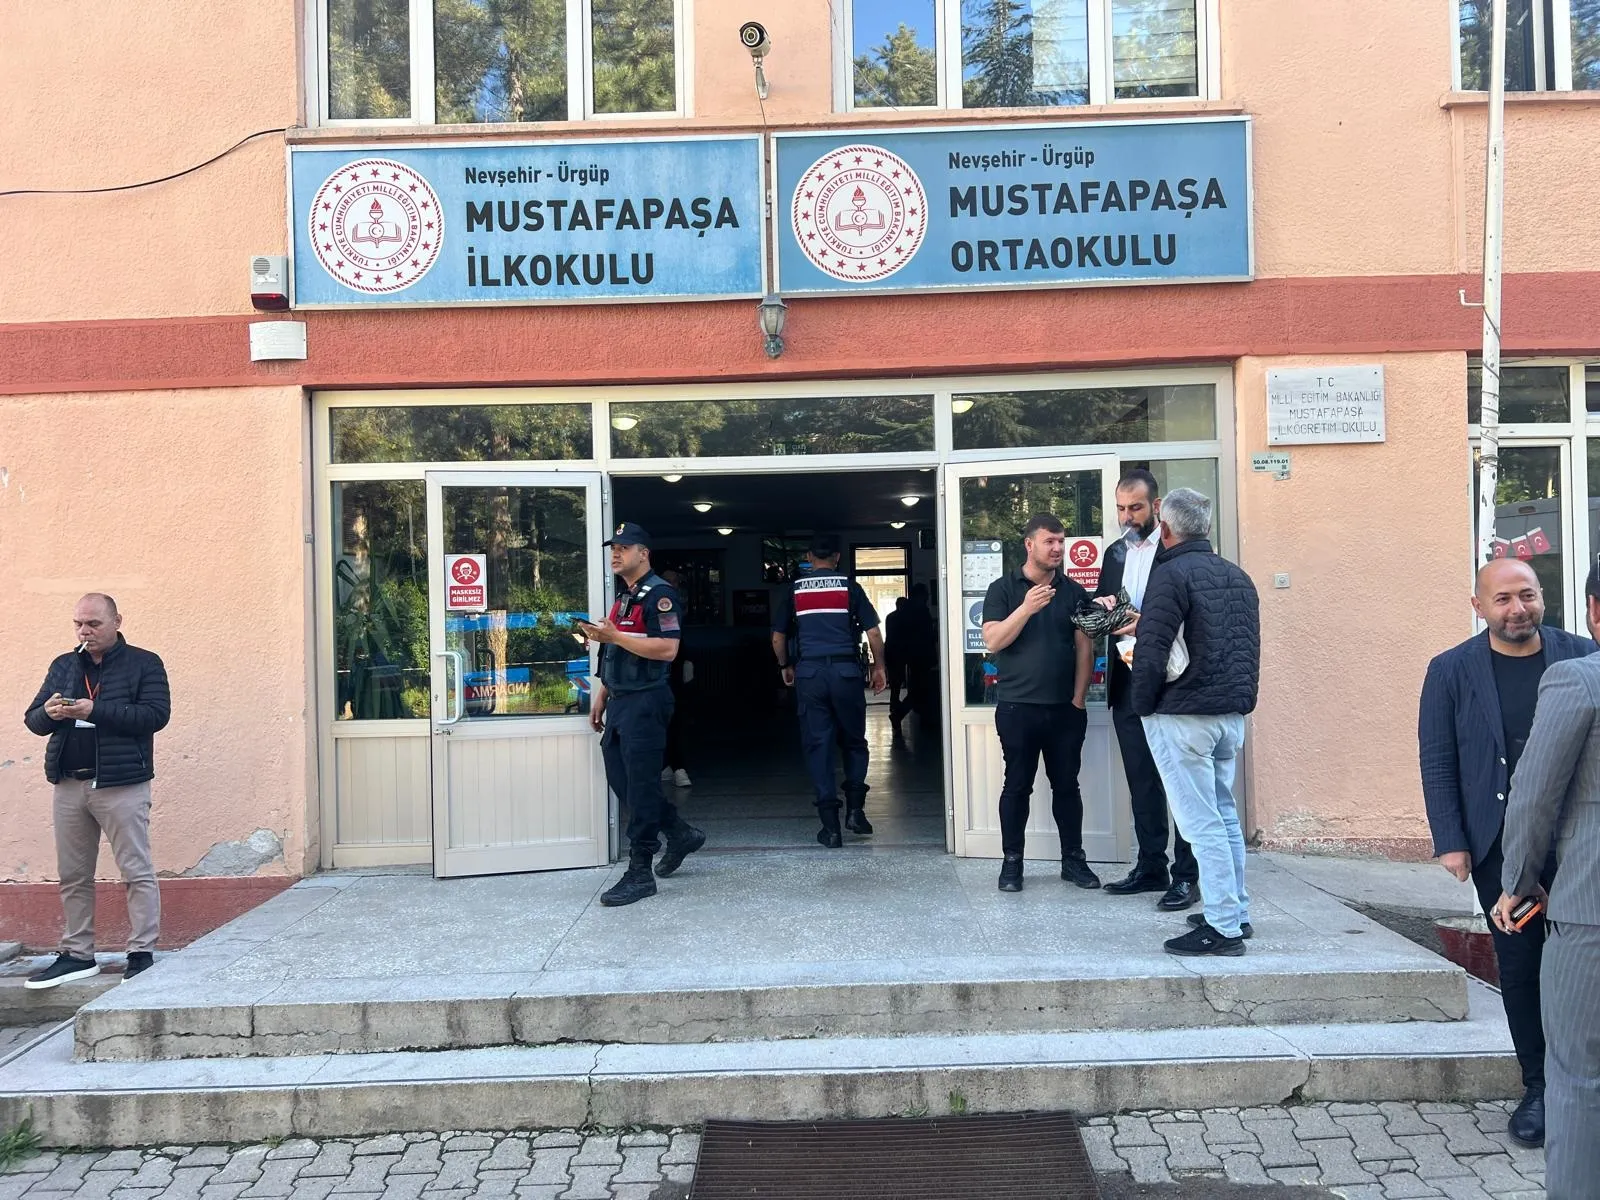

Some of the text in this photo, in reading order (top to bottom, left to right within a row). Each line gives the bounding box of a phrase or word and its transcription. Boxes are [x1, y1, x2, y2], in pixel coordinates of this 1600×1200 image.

[949, 150, 1026, 172] Nevşehir
[1042, 147, 1095, 169] Ürgüp
[465, 167, 541, 188] Nevşehir
[558, 161, 610, 186] Ürgüp
[950, 178, 1228, 219] MUSTAFAPAŞA
[335, 184, 418, 267] TÜRKİYE CUMHURİYETİ MİLLİ EĞİTİM BAKANLIĞI
[466, 197, 740, 238] MUSTAFAPAŞA
[817, 171, 902, 255] TÜRKİYE CUMHURİYETİ MİLLİ EĞİTİM BAKANLIĞI
[951, 234, 1177, 272] ORTAOKULU
[467, 247, 654, 287] İLKOKULU
[1342, 421, 1377, 433] OKULU
[799, 578, 842, 590] JANDARMA
[1068, 570, 1100, 578] MASKESİZ
[451, 587, 482, 595] MASKESİZ
[452, 595, 481, 603] GİRİLMEZ
